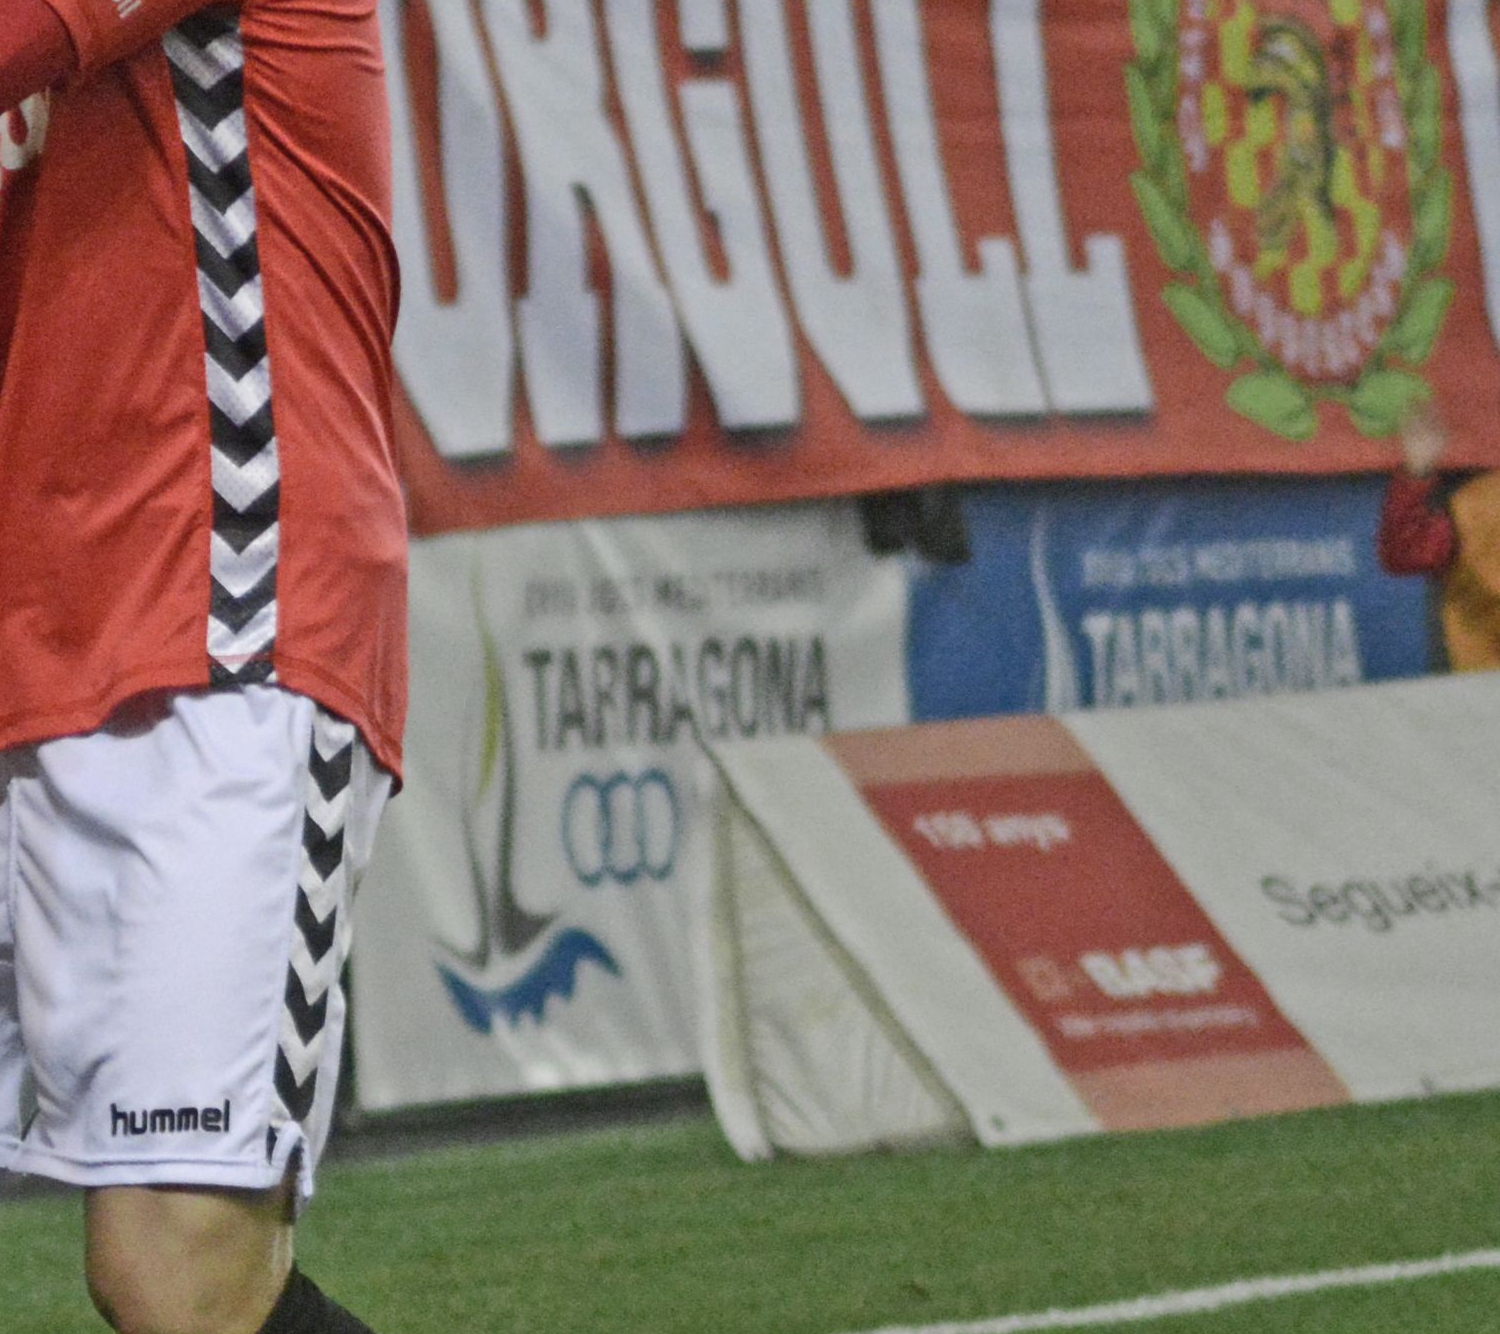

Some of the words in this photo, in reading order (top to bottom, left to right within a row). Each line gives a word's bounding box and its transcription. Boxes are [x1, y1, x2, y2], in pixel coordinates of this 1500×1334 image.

[522, 635, 831, 751] TARRAGONA
[1083, 595, 1361, 709] TARRAGONA
[110, 1098, 231, 1137] hummel
